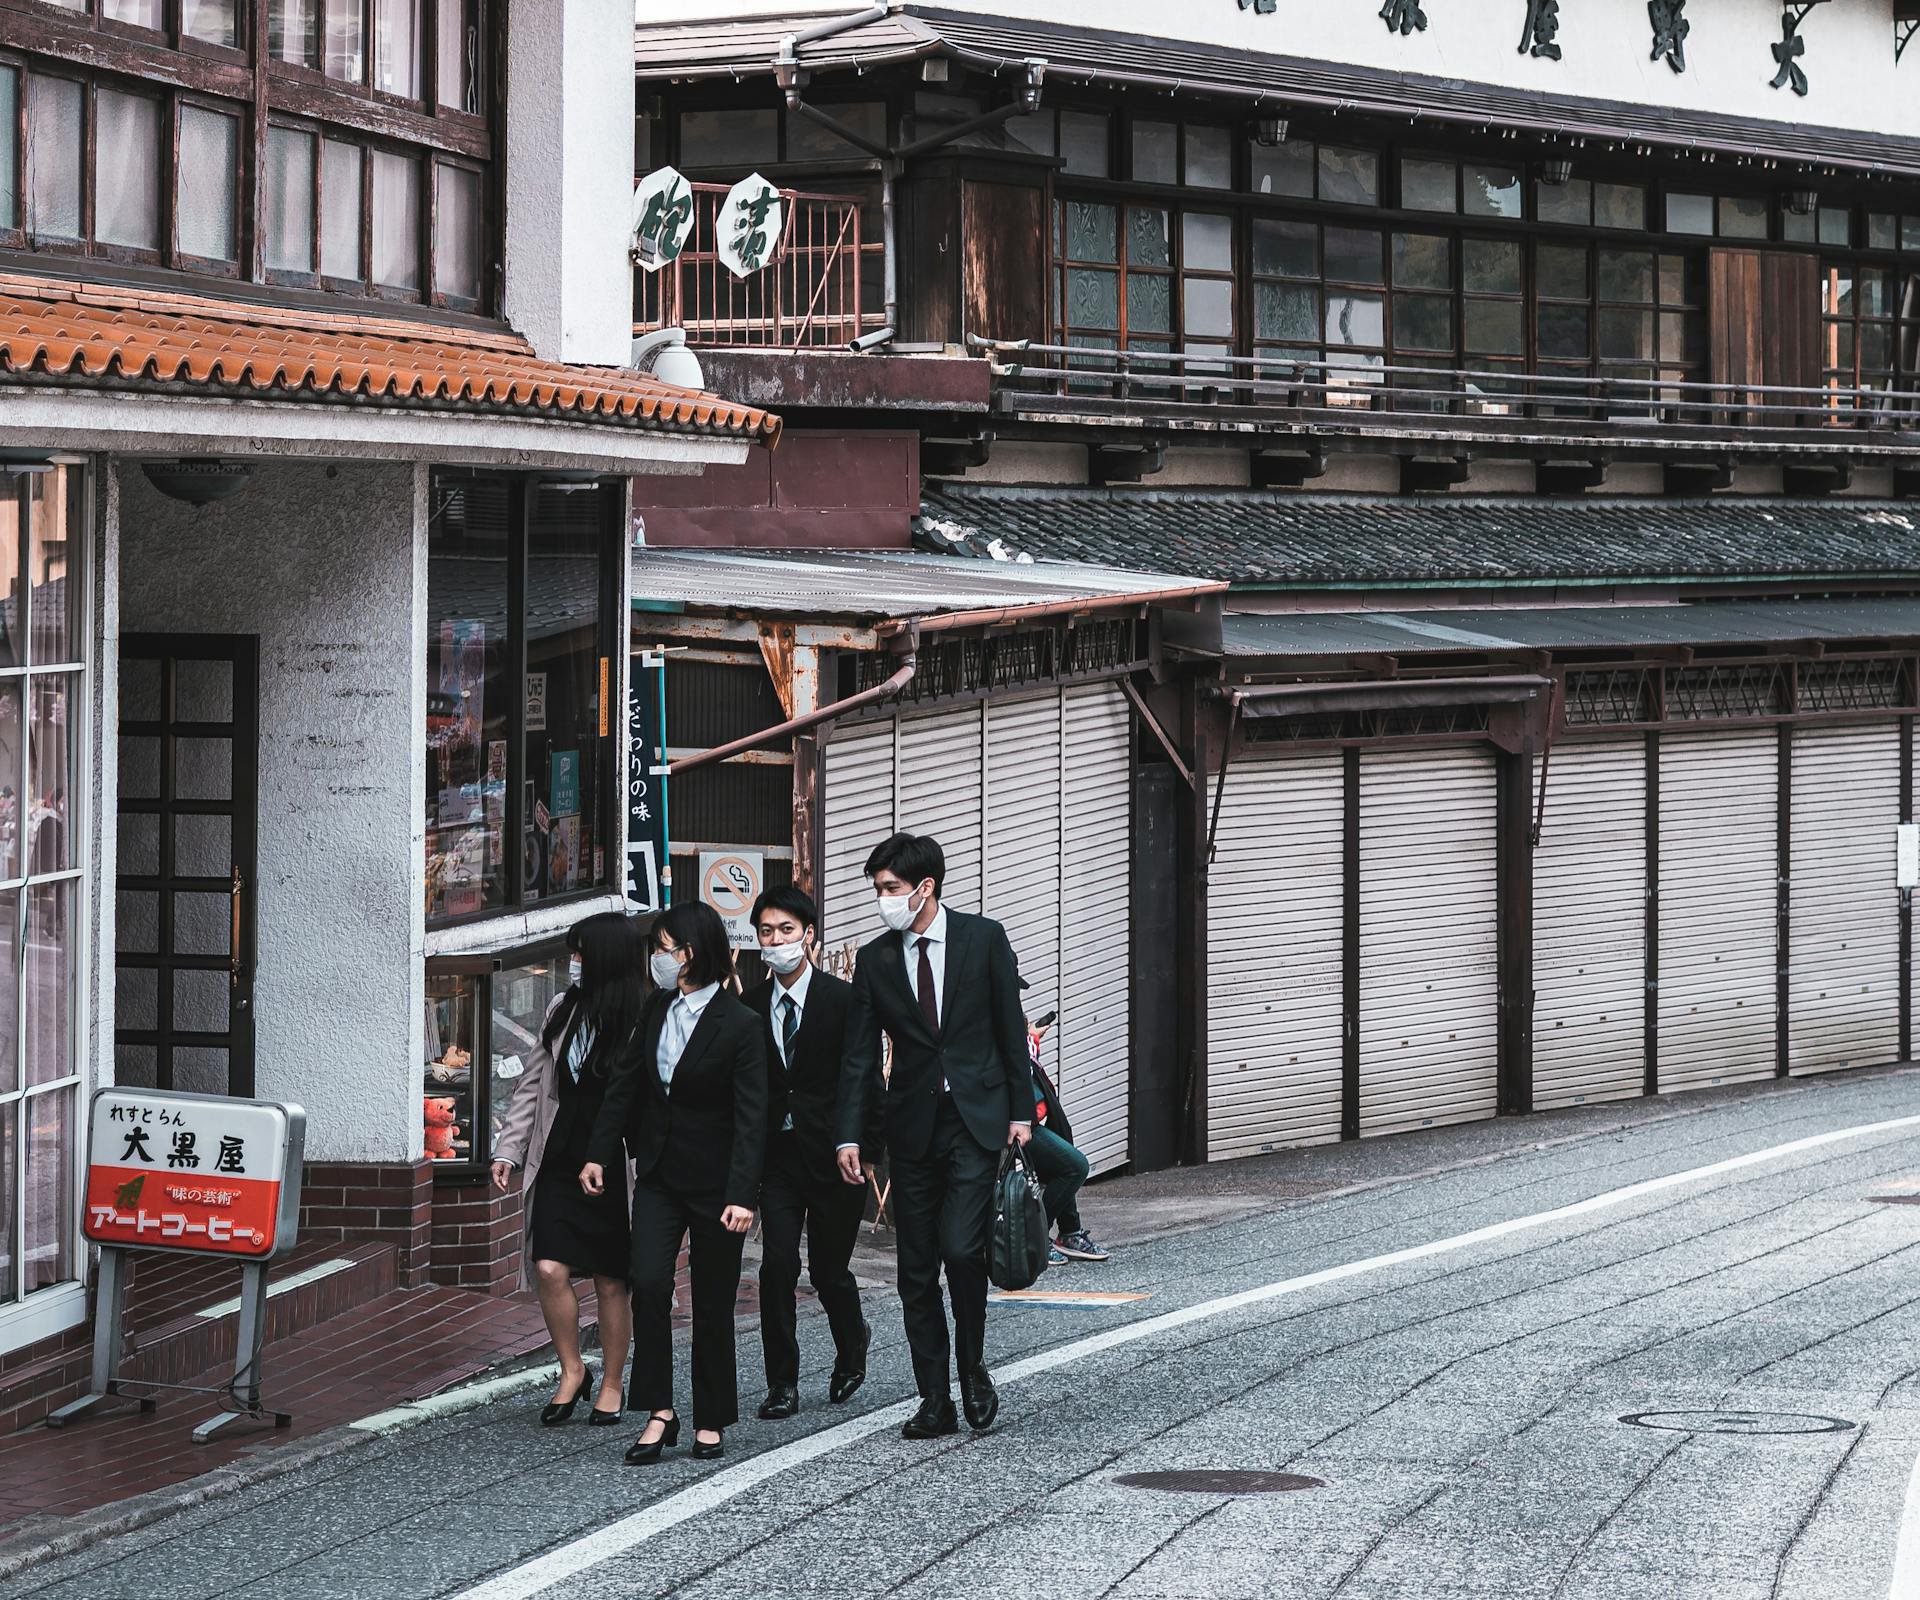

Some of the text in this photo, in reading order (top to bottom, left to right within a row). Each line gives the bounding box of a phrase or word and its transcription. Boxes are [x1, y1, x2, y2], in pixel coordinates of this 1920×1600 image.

[728, 933, 754, 943] moking
[110, 1104, 186, 1127] れすとらん
[120, 1126, 246, 1174] 大黒屋
